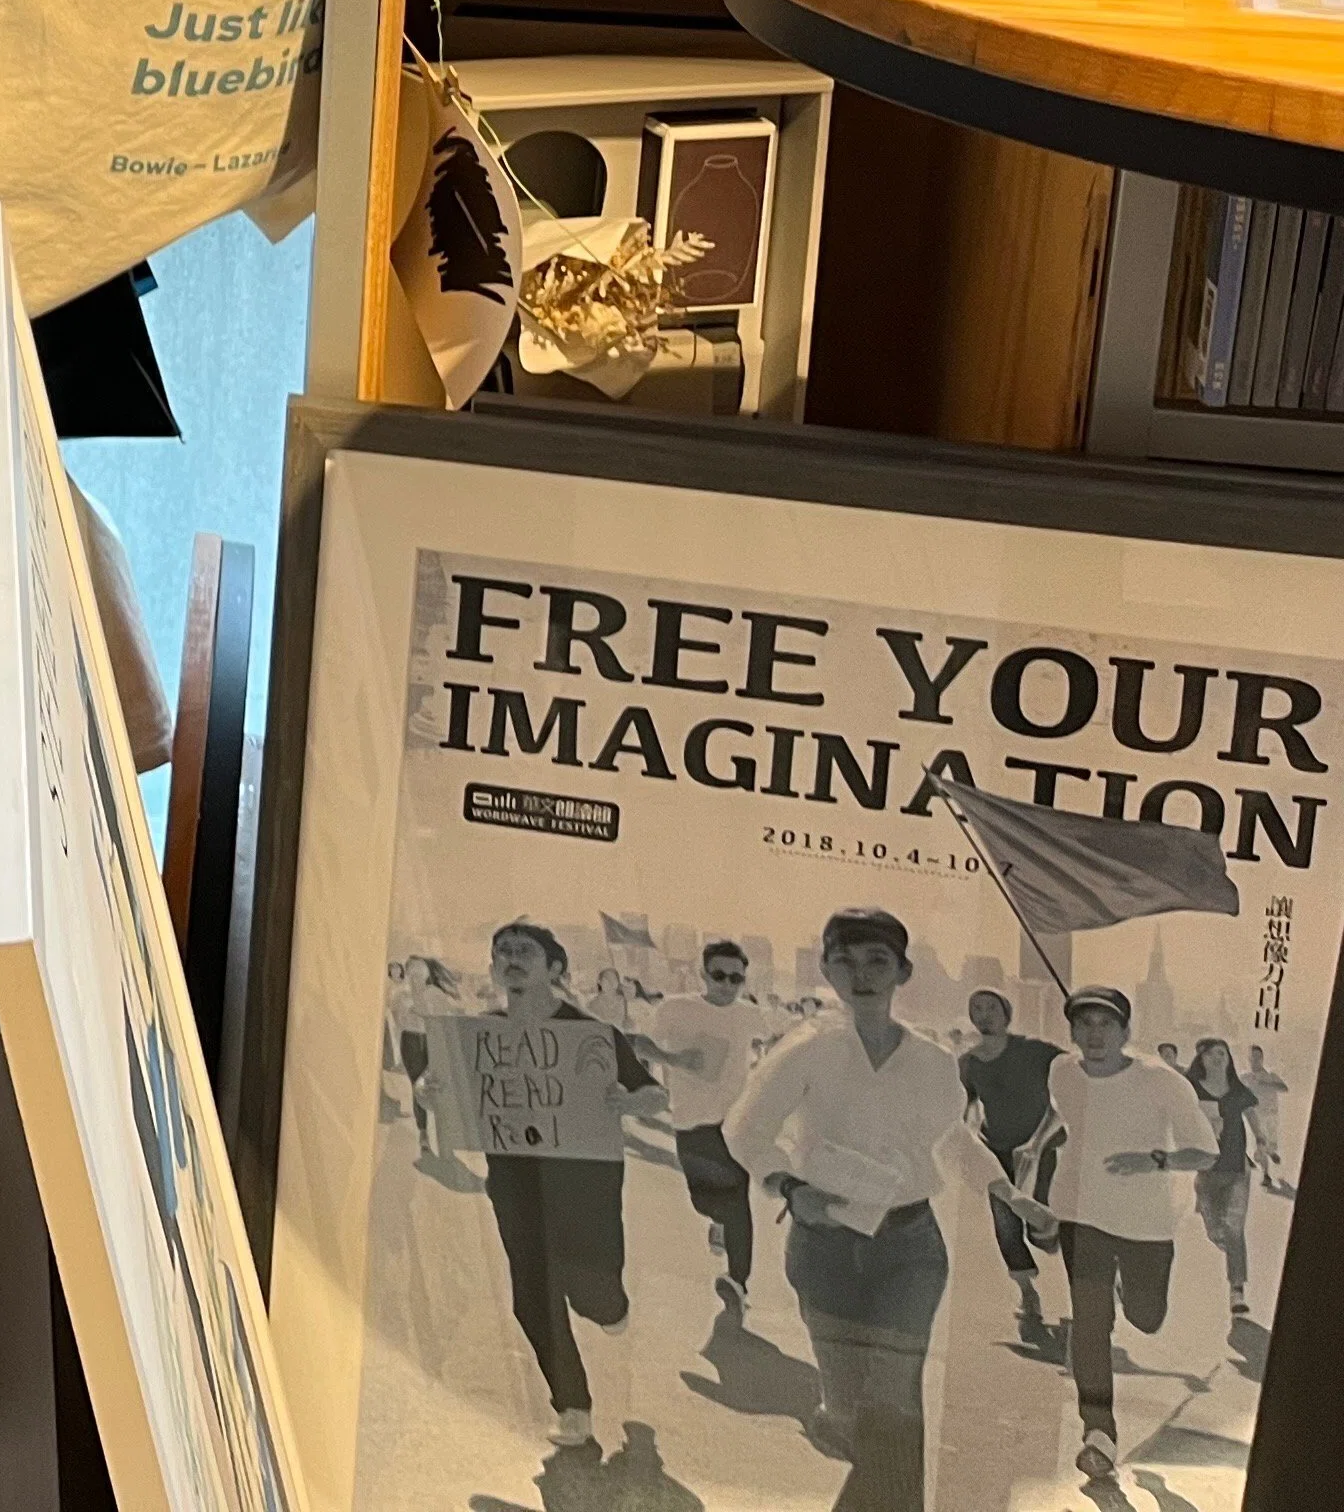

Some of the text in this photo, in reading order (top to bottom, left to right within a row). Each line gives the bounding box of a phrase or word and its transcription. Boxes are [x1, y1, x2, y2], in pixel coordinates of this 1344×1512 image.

[144, 2, 268, 42] Just
[110, 155, 188, 176] Bowie
[445, 574, 1328, 774] FREE YOUR
[439, 681, 1327, 870] IMAGINATION
[550, 818, 610, 838] FESTIVAL
[475, 1027, 560, 1072] READ
[479, 1072, 564, 1118] READ
